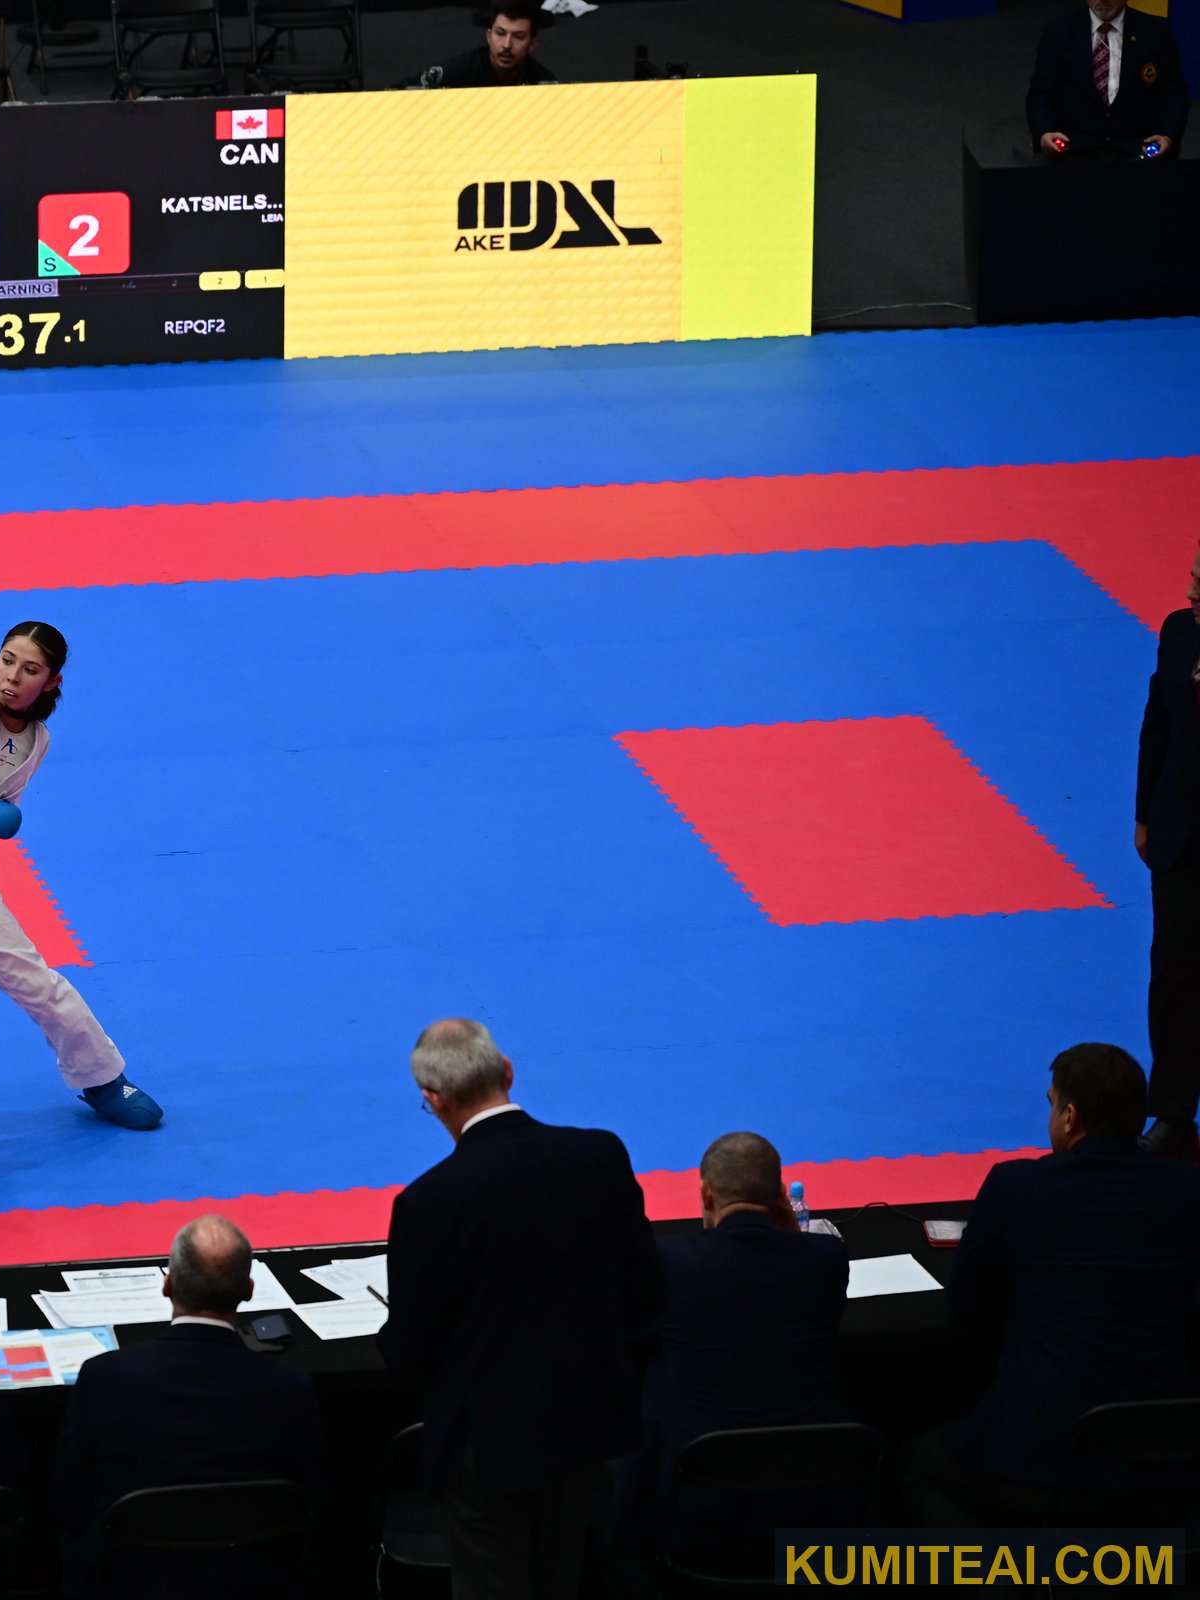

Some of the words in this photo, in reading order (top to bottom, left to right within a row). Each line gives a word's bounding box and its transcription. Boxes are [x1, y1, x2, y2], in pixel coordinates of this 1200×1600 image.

[220, 143, 279, 165] CAN
[161, 194, 283, 213] KATSNELS...
[261, 213, 284, 223] LEIA
[68, 215, 100, 257] 2
[454, 235, 505, 252] AKE
[44, 257, 57, 272] S
[164, 319, 226, 335] REPQF2
